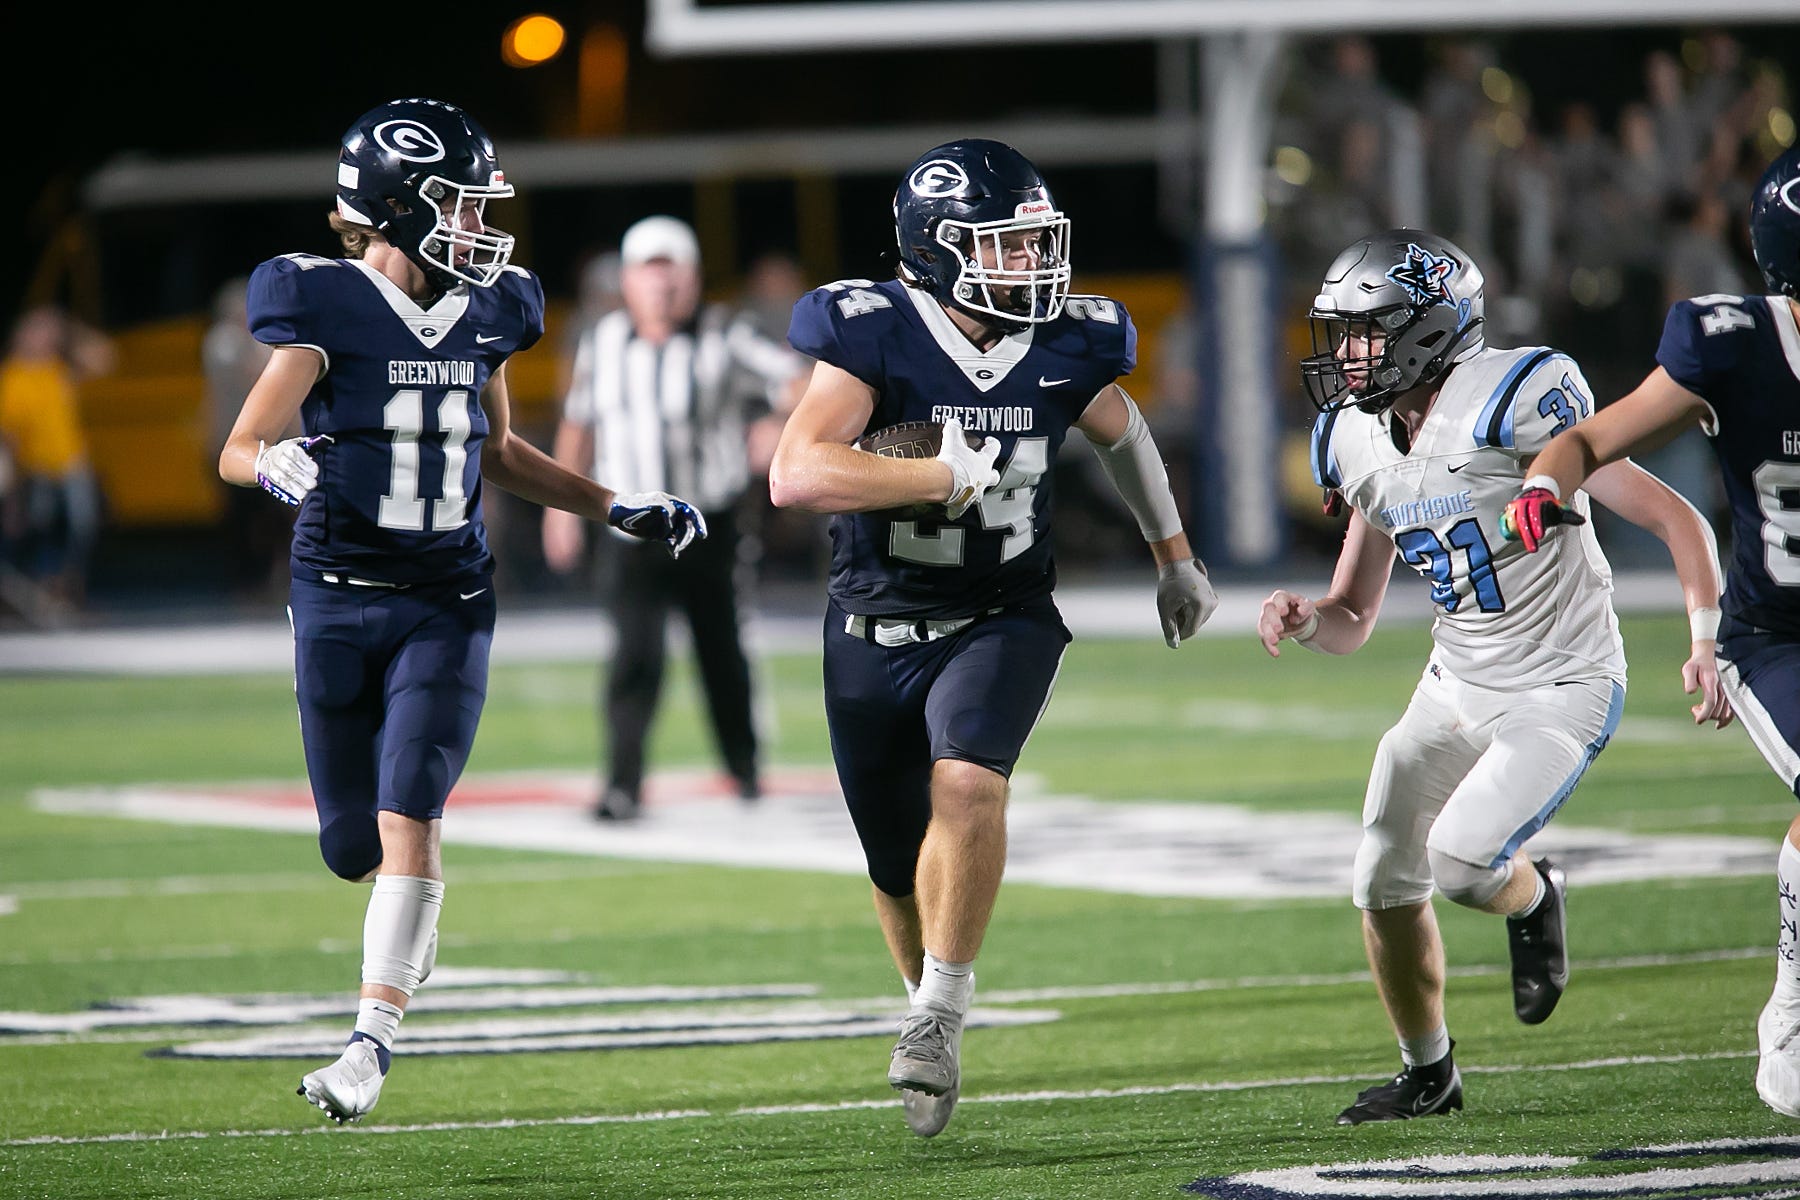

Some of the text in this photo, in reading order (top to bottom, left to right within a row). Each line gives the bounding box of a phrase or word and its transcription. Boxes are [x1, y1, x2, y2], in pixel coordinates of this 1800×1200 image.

[388, 360, 475, 385] GREENWOOD
[1537, 371, 1590, 438] 31
[377, 389, 471, 531] 11
[1380, 489, 1476, 528] SOUTHSIDE
[1752, 460, 1800, 587] 8
[1394, 517, 1506, 613] 31
